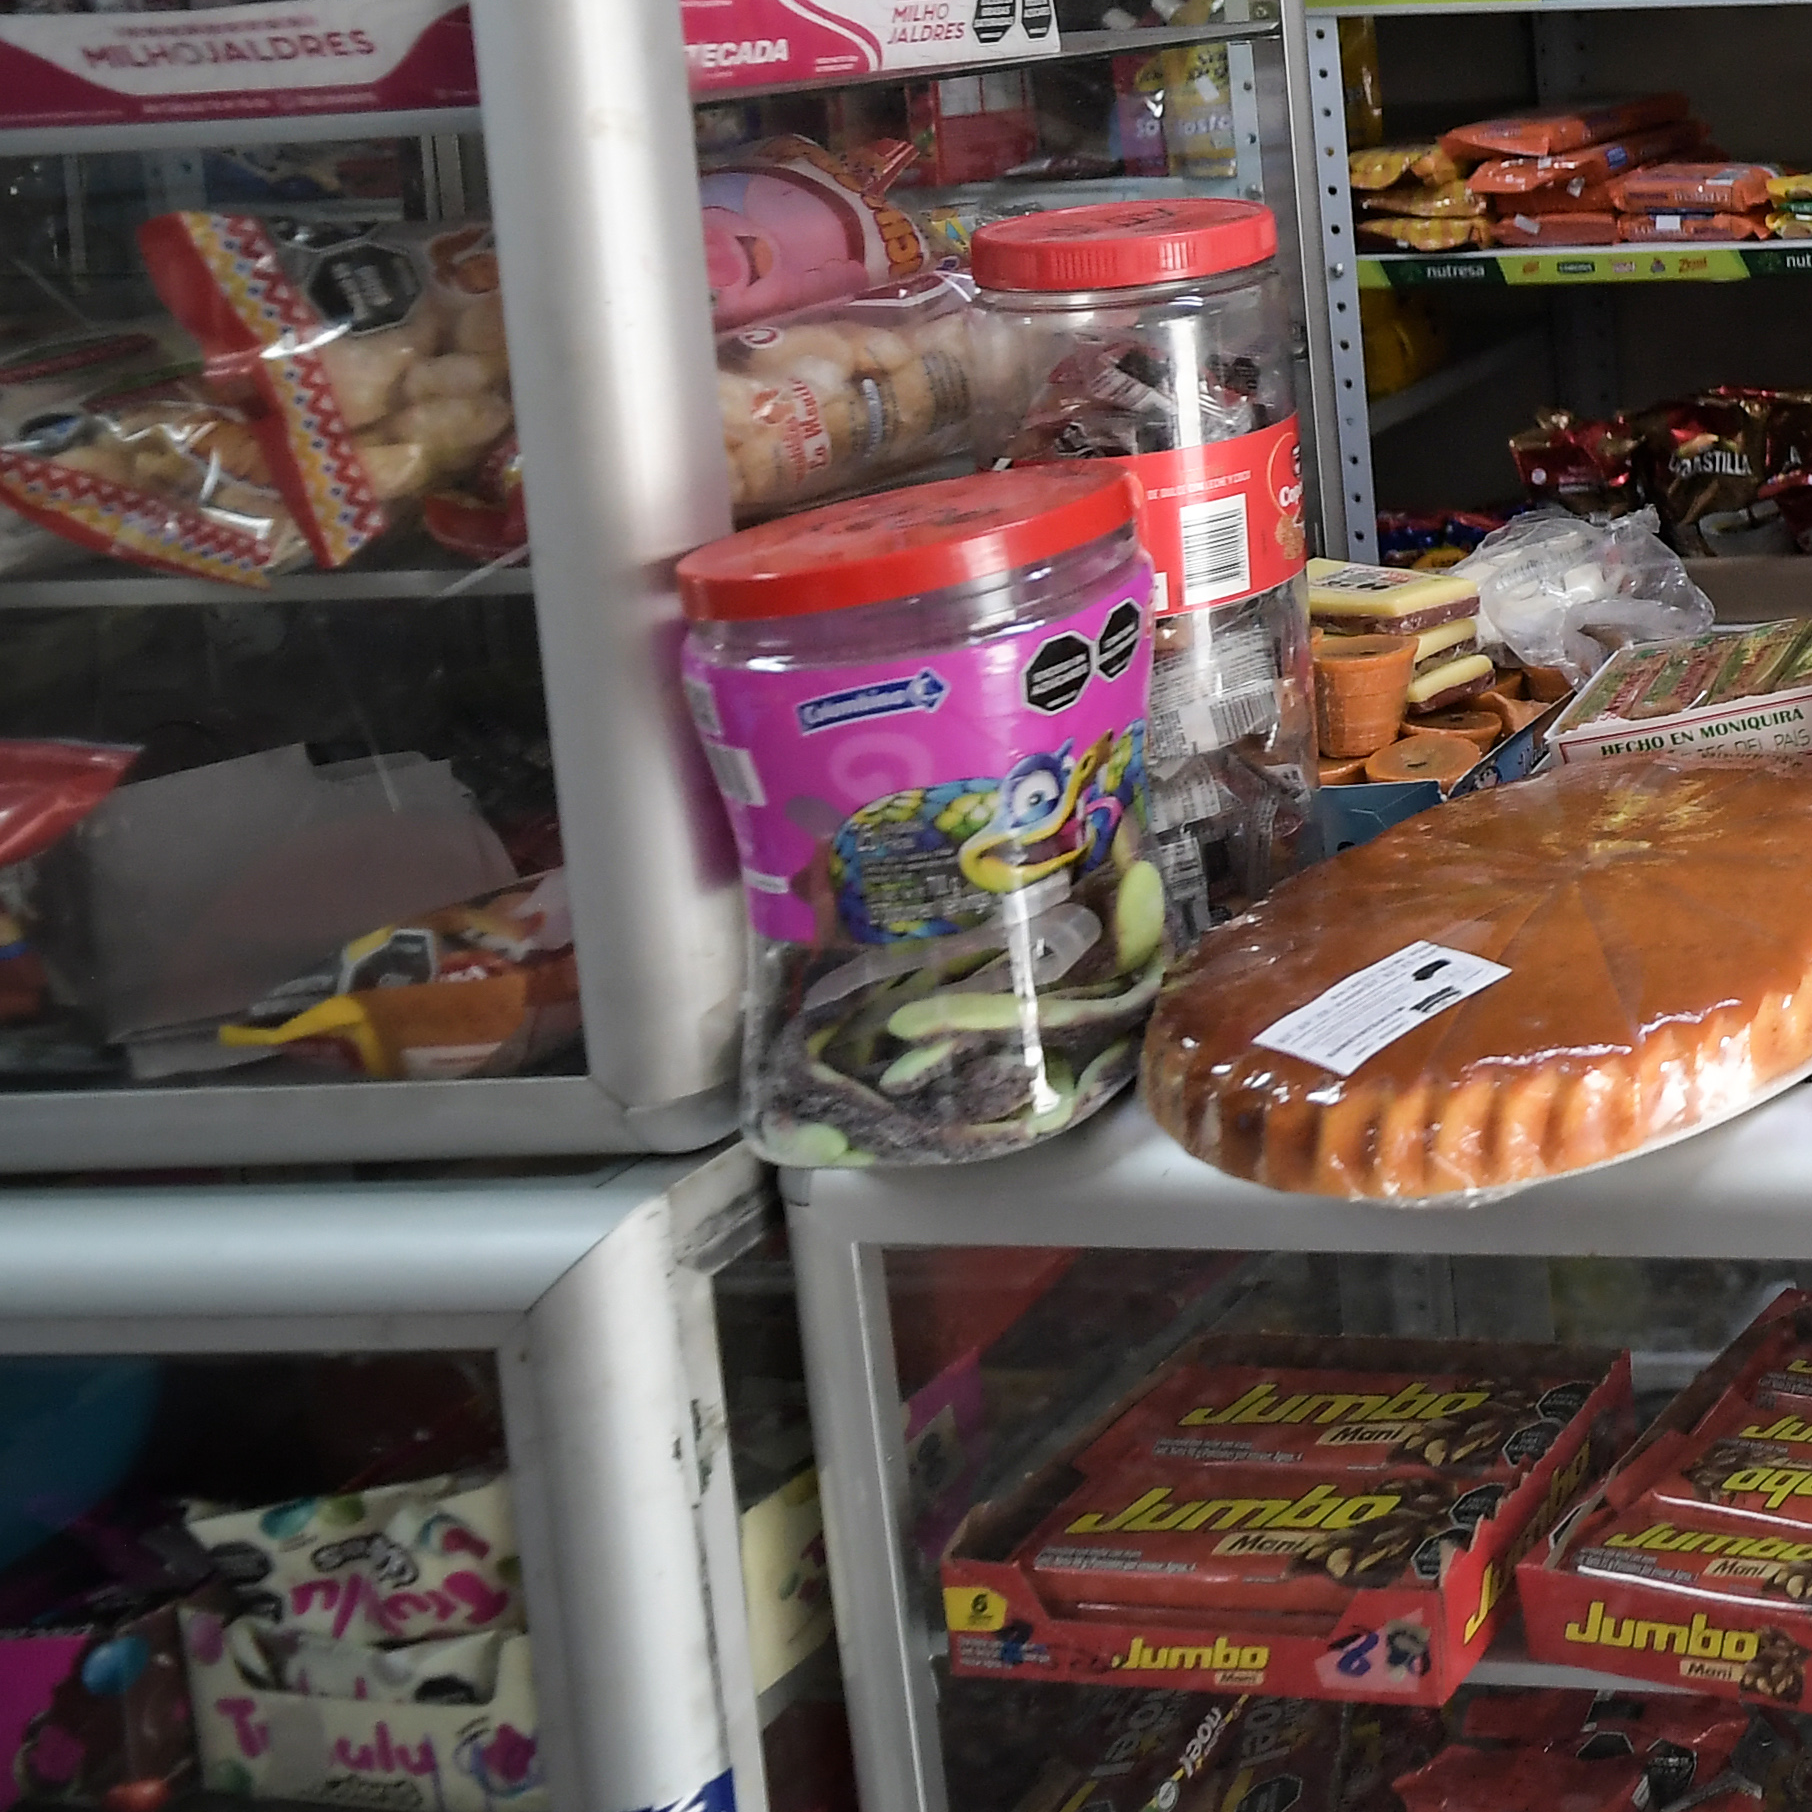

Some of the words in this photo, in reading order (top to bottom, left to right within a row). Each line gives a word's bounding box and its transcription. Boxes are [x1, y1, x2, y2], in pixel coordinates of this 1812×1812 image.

[892, 4, 949, 22] MILHO
[83, 30, 373, 67] MILHOJALDRES
[888, 22, 965, 44] JALDRES
[1601, 734, 1664, 757] HECHO
[1671, 729, 1686, 747] EN
[1184, 1383, 1486, 1428] Jumbo
[1078, 1484, 1403, 1535] Jumbo
